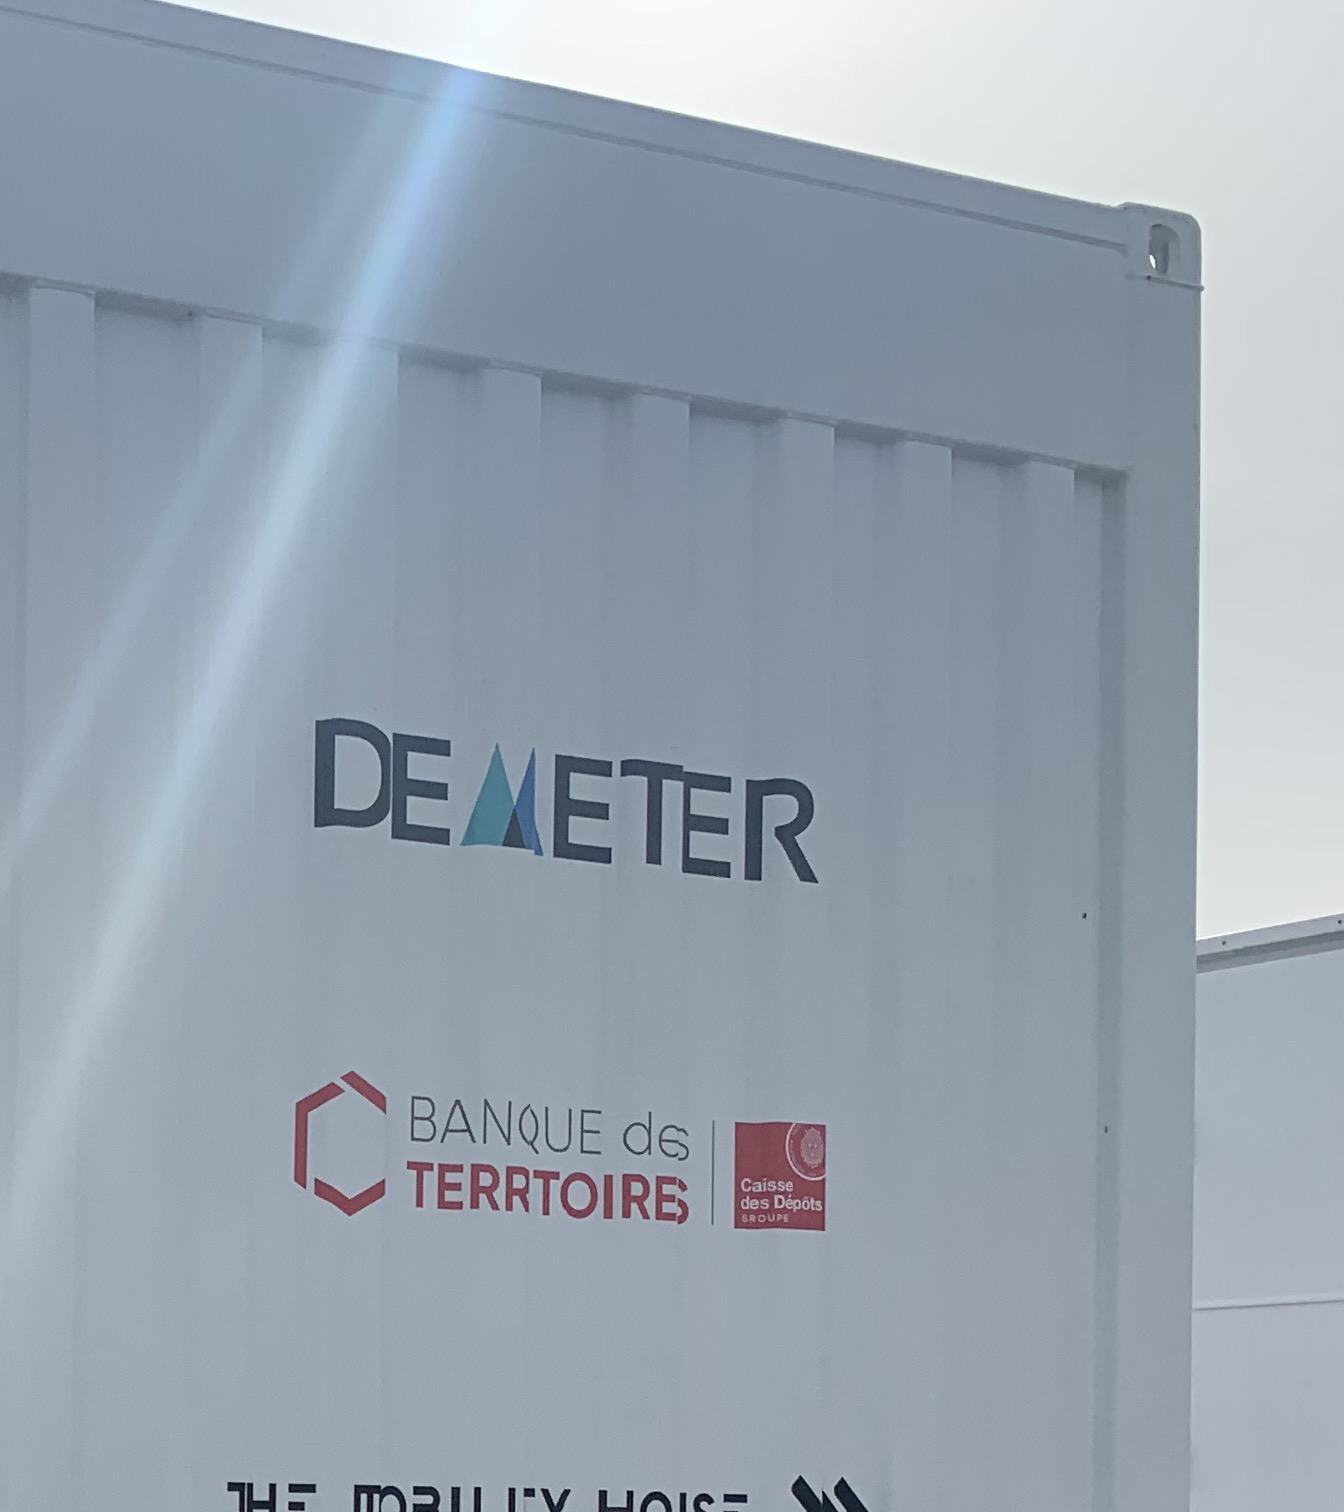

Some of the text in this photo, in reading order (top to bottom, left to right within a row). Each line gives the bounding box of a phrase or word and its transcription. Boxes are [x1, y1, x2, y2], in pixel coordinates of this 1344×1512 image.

[314, 718, 818, 884] DEMETER
[410, 1095, 602, 1155] BANQUE
[740, 1178, 794, 1192] Caisse
[740, 1194, 823, 1212] des Dépôts
[741, 1213, 789, 1223] GROUPE
